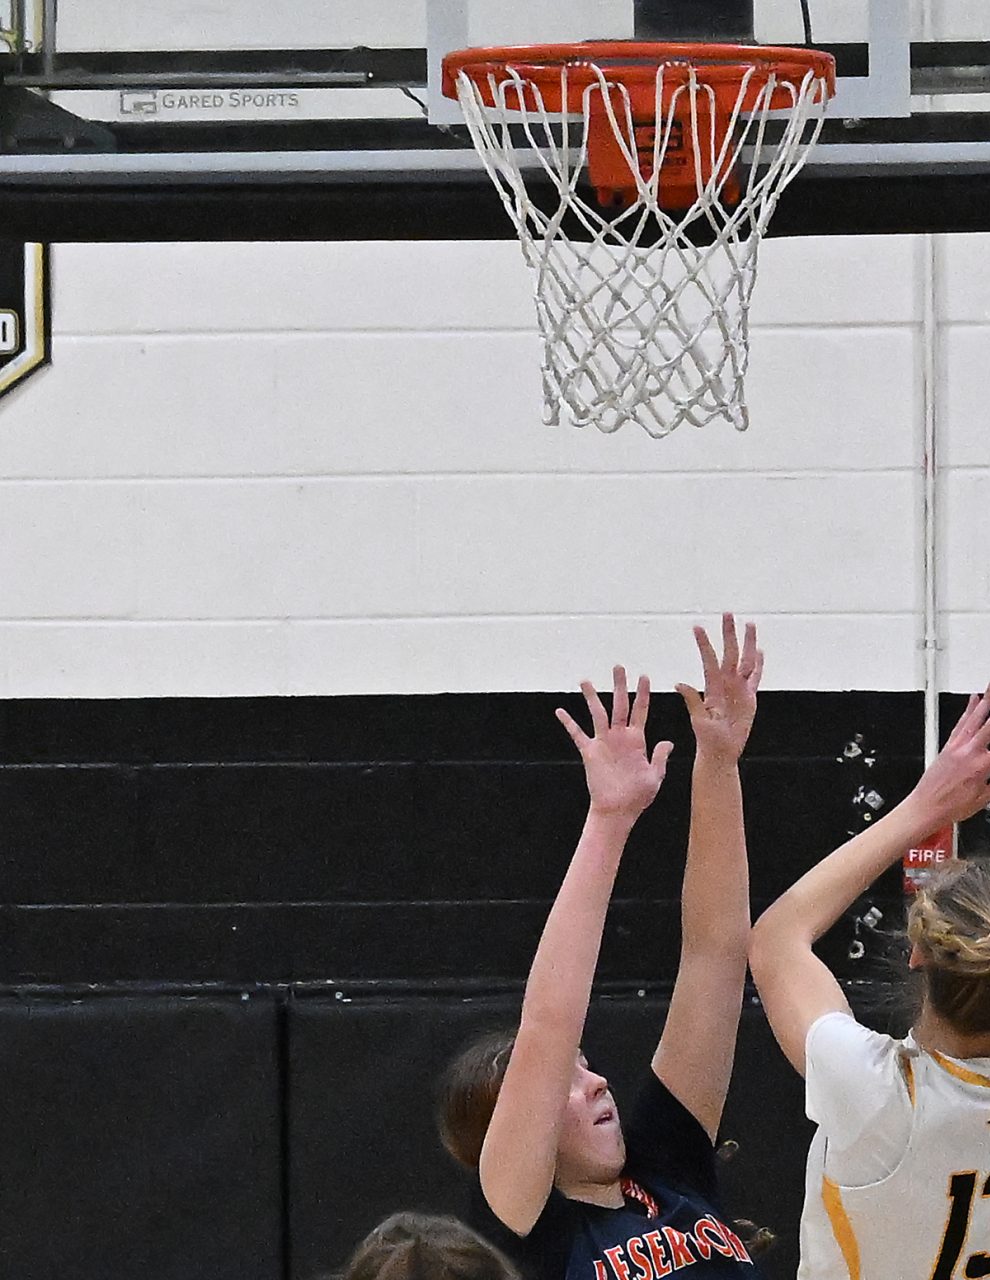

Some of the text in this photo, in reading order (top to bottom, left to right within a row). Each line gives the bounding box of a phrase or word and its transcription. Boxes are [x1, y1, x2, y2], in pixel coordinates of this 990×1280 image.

[162, 93, 224, 109] GARED
[229, 91, 299, 108] SPORTS
[908, 848, 946, 863] FIRE
